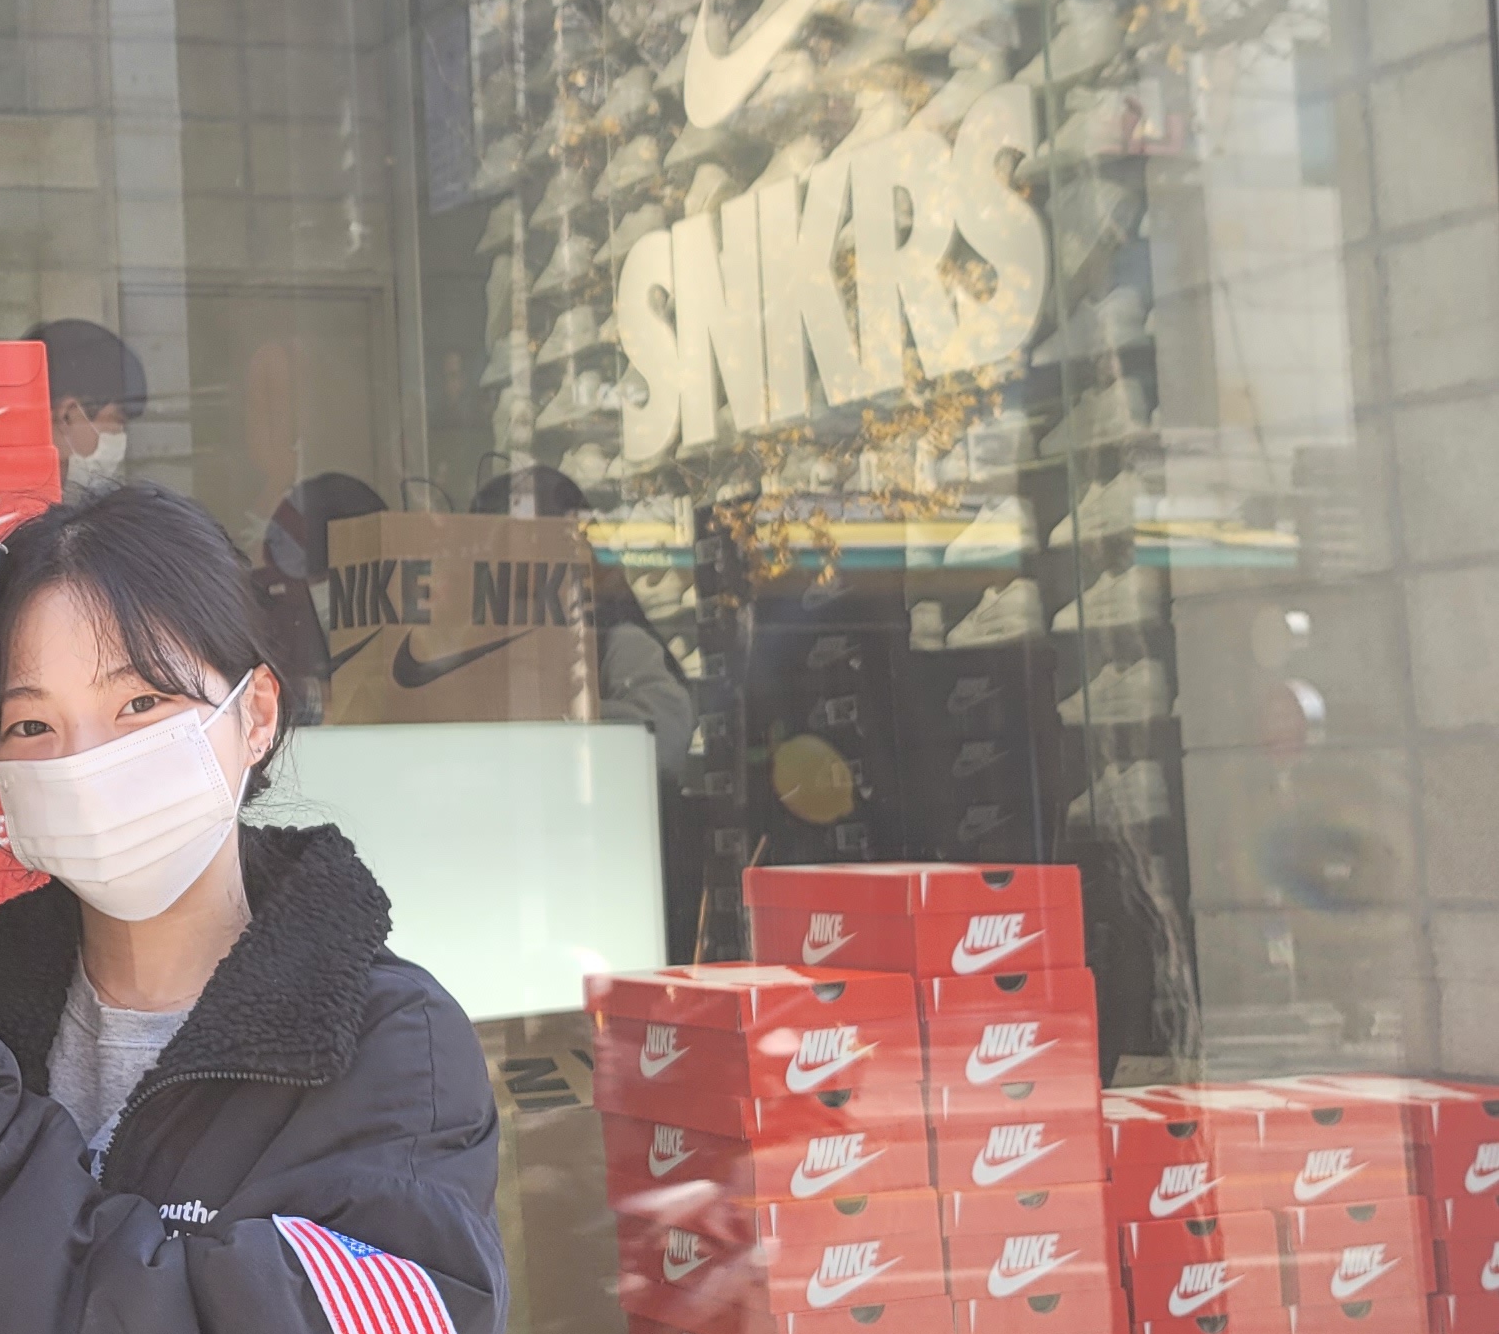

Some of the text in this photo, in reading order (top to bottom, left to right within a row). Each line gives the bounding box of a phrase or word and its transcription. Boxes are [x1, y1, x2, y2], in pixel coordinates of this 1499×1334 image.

[615, 84, 1053, 461] SNKRS
[329, 559, 595, 630] NIKE NIKE
[810, 913, 844, 943] NIKE
[965, 913, 1025, 948] NIKE
[646, 1027, 677, 1053] NIKE
[800, 1027, 857, 1063] NIKE
[981, 1023, 1041, 1060] NIKE
[655, 1125, 684, 1152] NIKE
[806, 1133, 864, 1170] NIKE
[987, 1124, 1045, 1163] NIKE
[1159, 1162, 1209, 1195] NIKE
[1302, 1148, 1353, 1178] NIKE
[668, 1230, 701, 1261] NIKE
[821, 1241, 881, 1282] NIKE
[1001, 1234, 1061, 1273] NIKE
[1338, 1244, 1385, 1276] NIKE
[1176, 1262, 1227, 1294] NIKE
